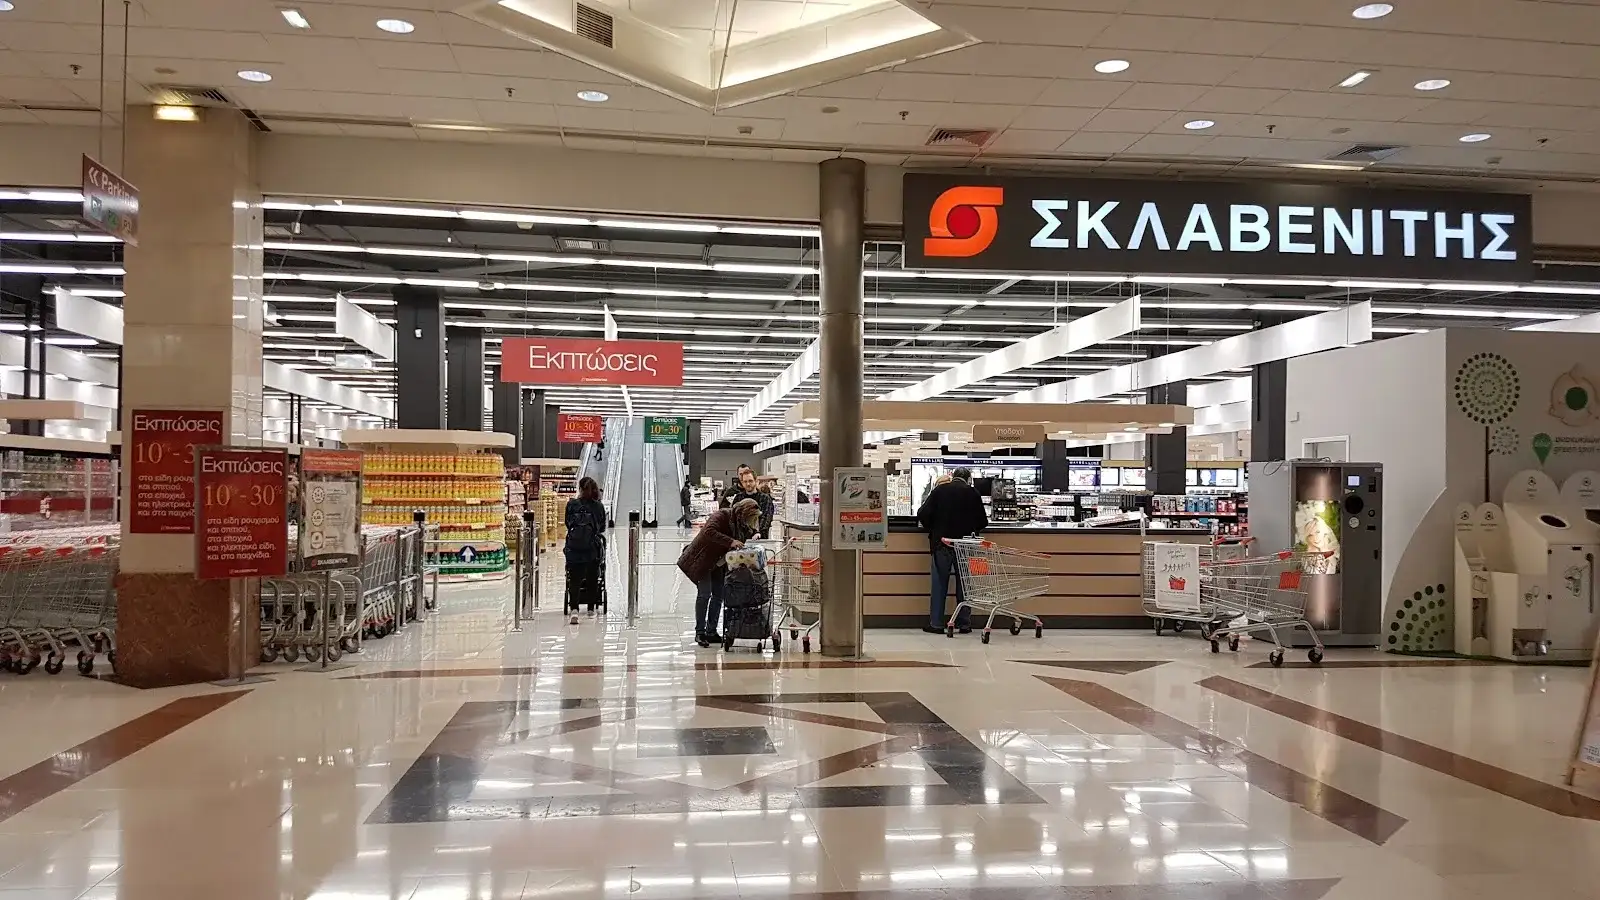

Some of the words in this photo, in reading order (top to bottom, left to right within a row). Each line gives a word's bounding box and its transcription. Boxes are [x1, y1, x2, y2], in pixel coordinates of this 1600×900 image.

[1030, 199, 1517, 261] ΣΚΛΑΒΕΝΙΤΗΣ
[529, 345, 658, 376] Εκπτώσεις
[134, 414, 220, 435] Εκπτώσεις
[994, 427, 1025, 436] Υποδοχή
[202, 456, 284, 476] Εκπτώσεις
[154, 491, 186, 501] εποχικά
[152, 500, 191, 509] ηλεκτρικά
[241, 515, 280, 526] ρουχισμού
[223, 534, 253, 544] εποχικά
[221, 543, 257, 553] ηλεκτρικά
